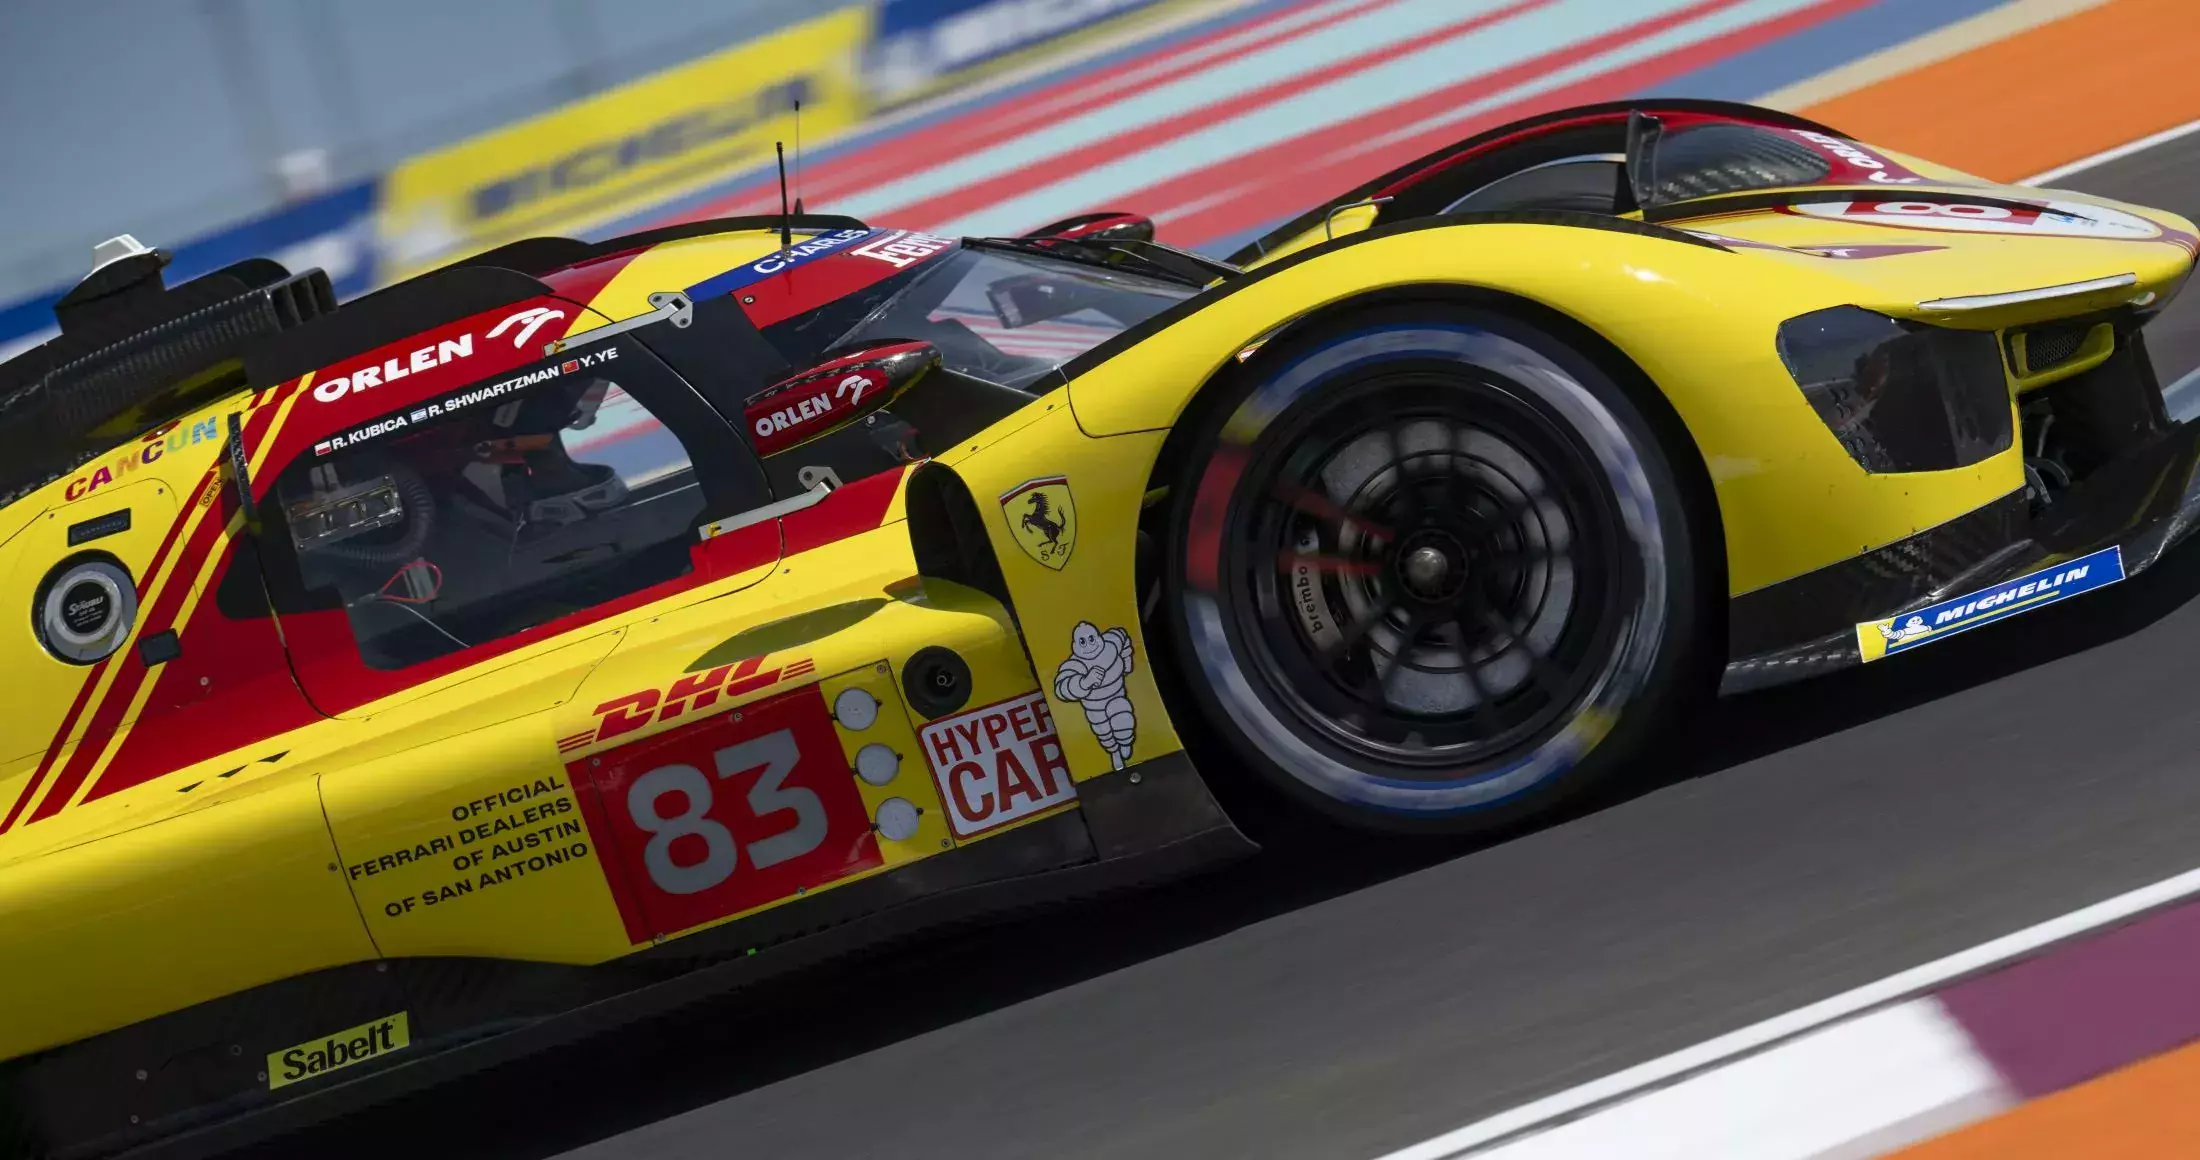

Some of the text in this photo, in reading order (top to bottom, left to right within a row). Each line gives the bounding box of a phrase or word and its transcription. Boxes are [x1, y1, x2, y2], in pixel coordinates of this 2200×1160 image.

[313, 333, 474, 403] ORLEN
[331, 347, 618, 450] R. KUBICA R. SHWARTZMAN Y. YE
[755, 393, 833, 437] ORLEN
[202, 478, 224, 504] OPEN
[1297, 565, 1325, 634] brembo
[1935, 565, 2090, 625] MICHELIN
[592, 655, 783, 742] DHL
[452, 776, 565, 821] OFFICIAL
[627, 728, 828, 895] 83
[349, 797, 572, 881] FERRARI DEALERS
[453, 818, 581, 871] OF AUSTIN
[385, 842, 588, 917] OF SAN ANTONIO
[282, 1021, 395, 1080] Sabelt
